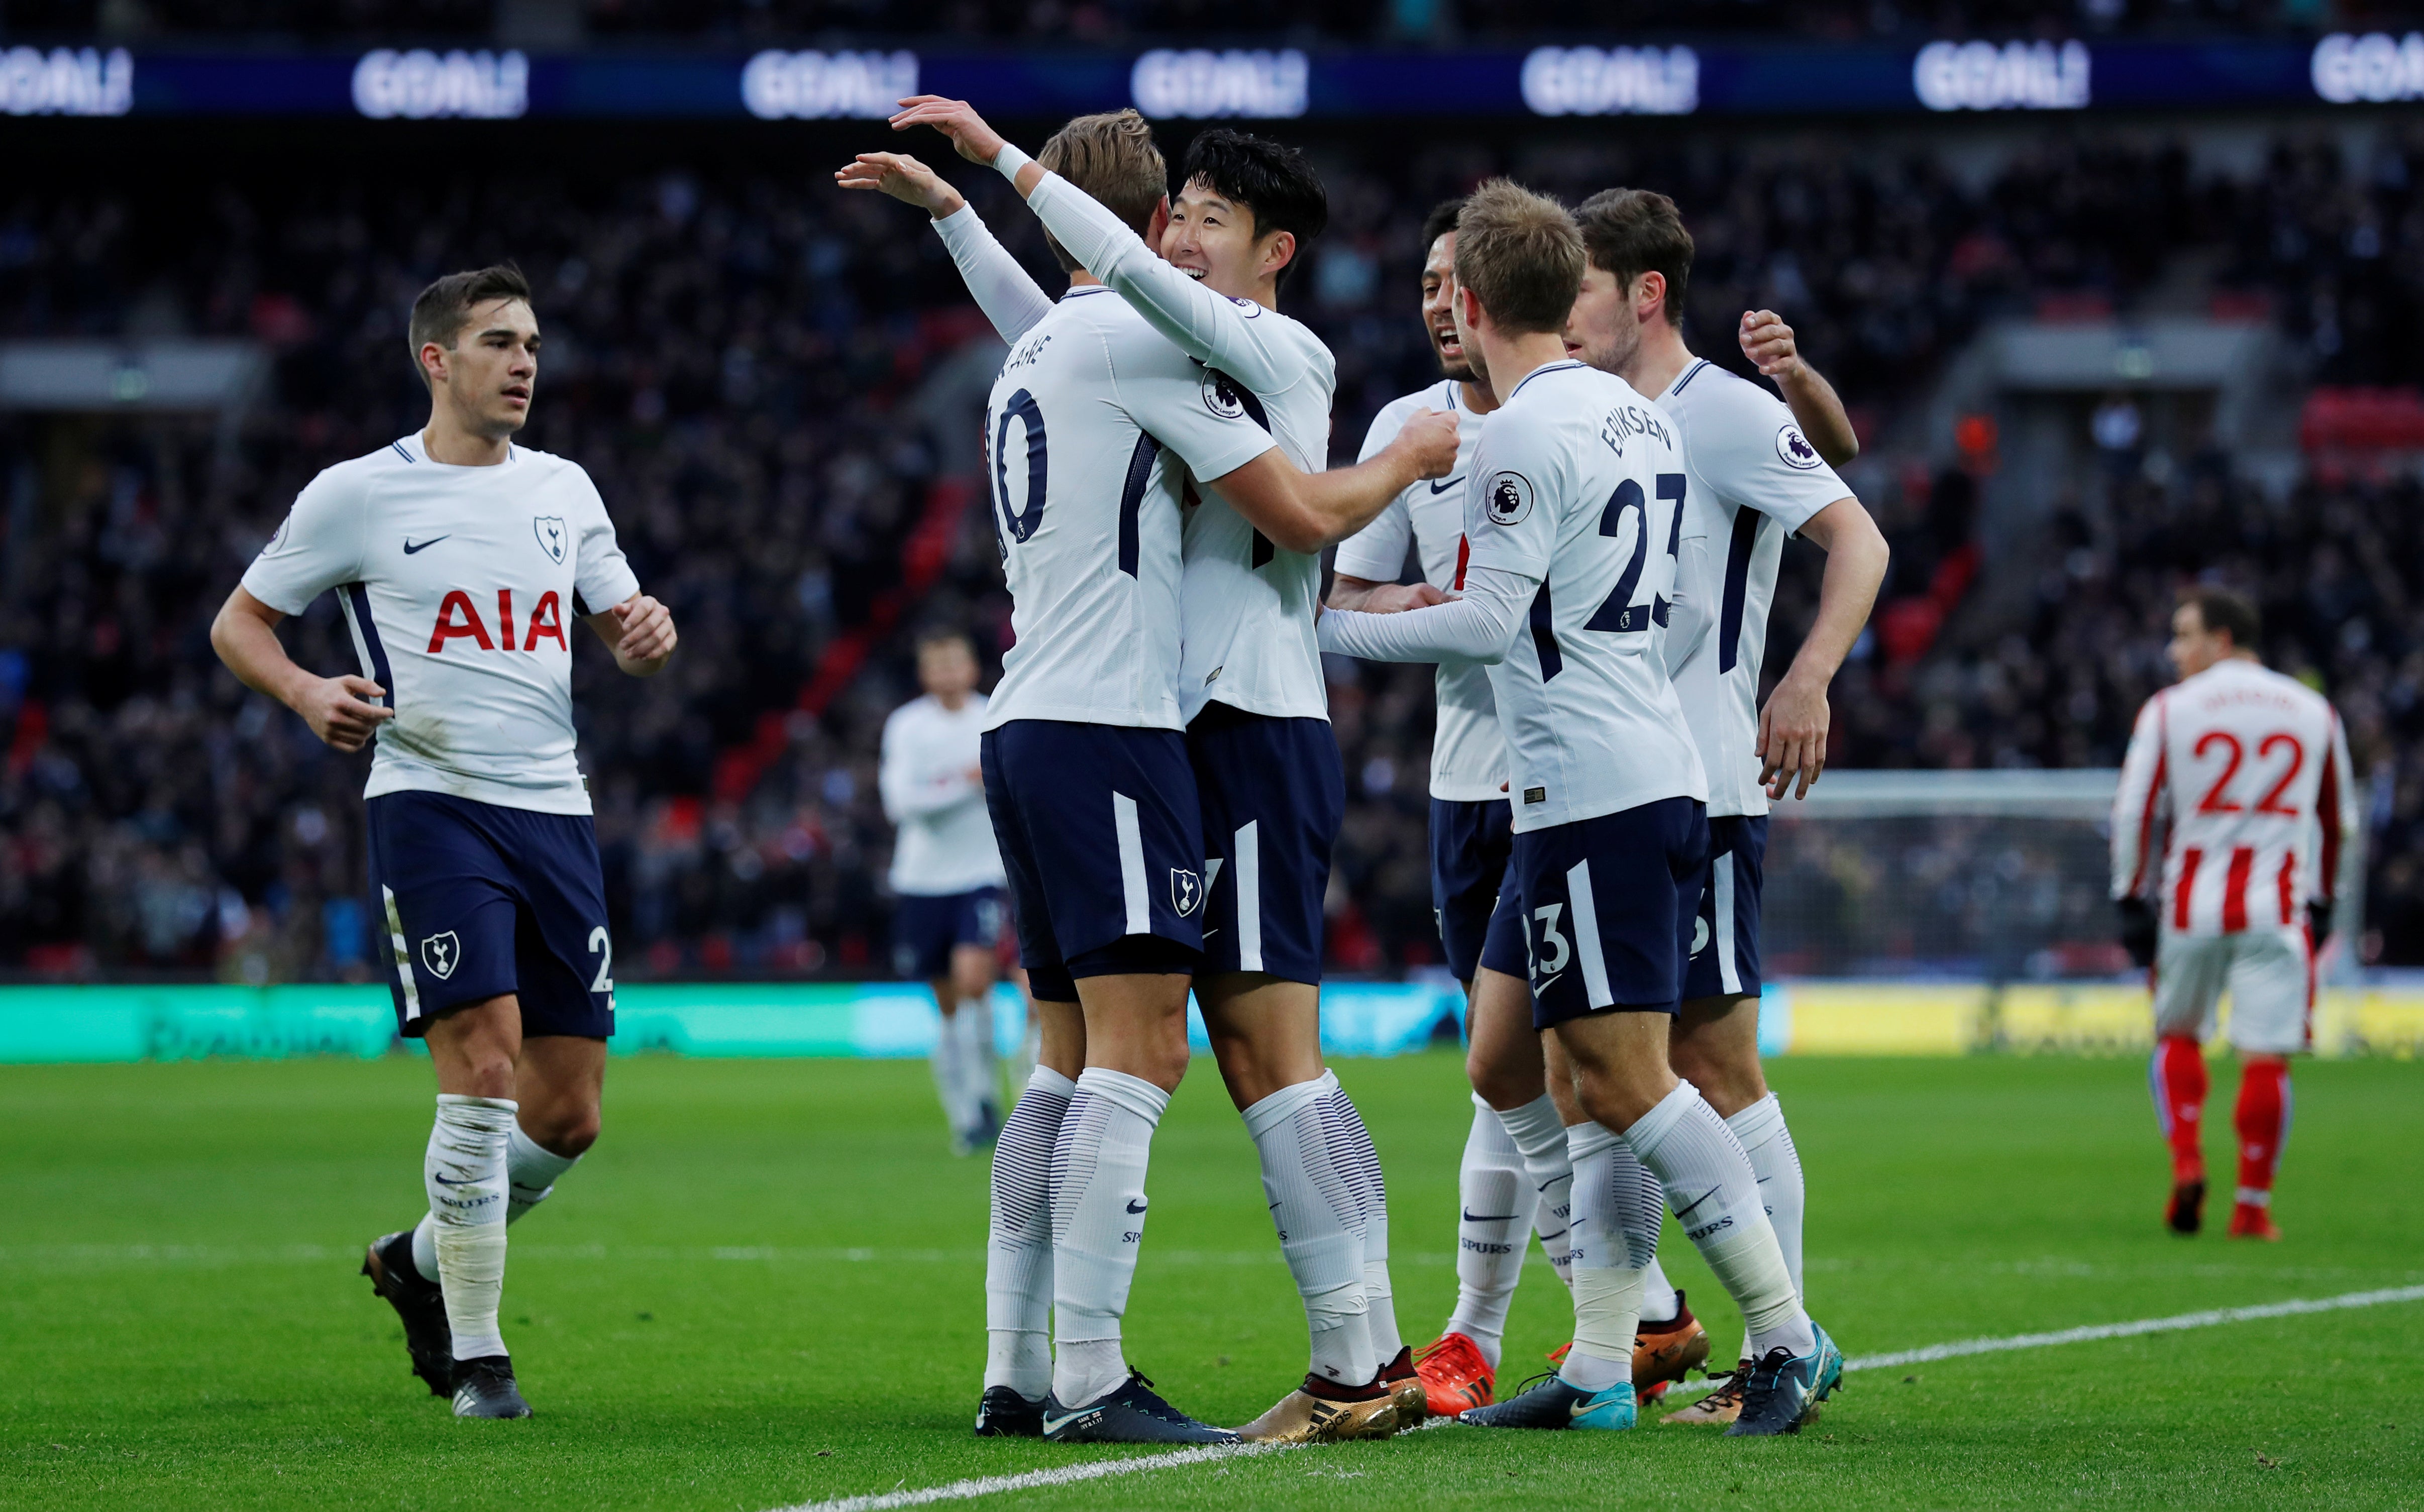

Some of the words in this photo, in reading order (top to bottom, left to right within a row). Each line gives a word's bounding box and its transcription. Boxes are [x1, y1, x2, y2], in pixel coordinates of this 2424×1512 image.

[1601, 406, 1672, 458] ERIKSEN
[1583, 473, 1687, 632] 23
[427, 589, 567, 653] AIA
[2193, 730, 2305, 818] 22
[1461, 1237, 1512, 1254] SPURS
[1685, 1216, 1733, 1241] PURS
[1077, 1415, 1090, 1424] KANE
